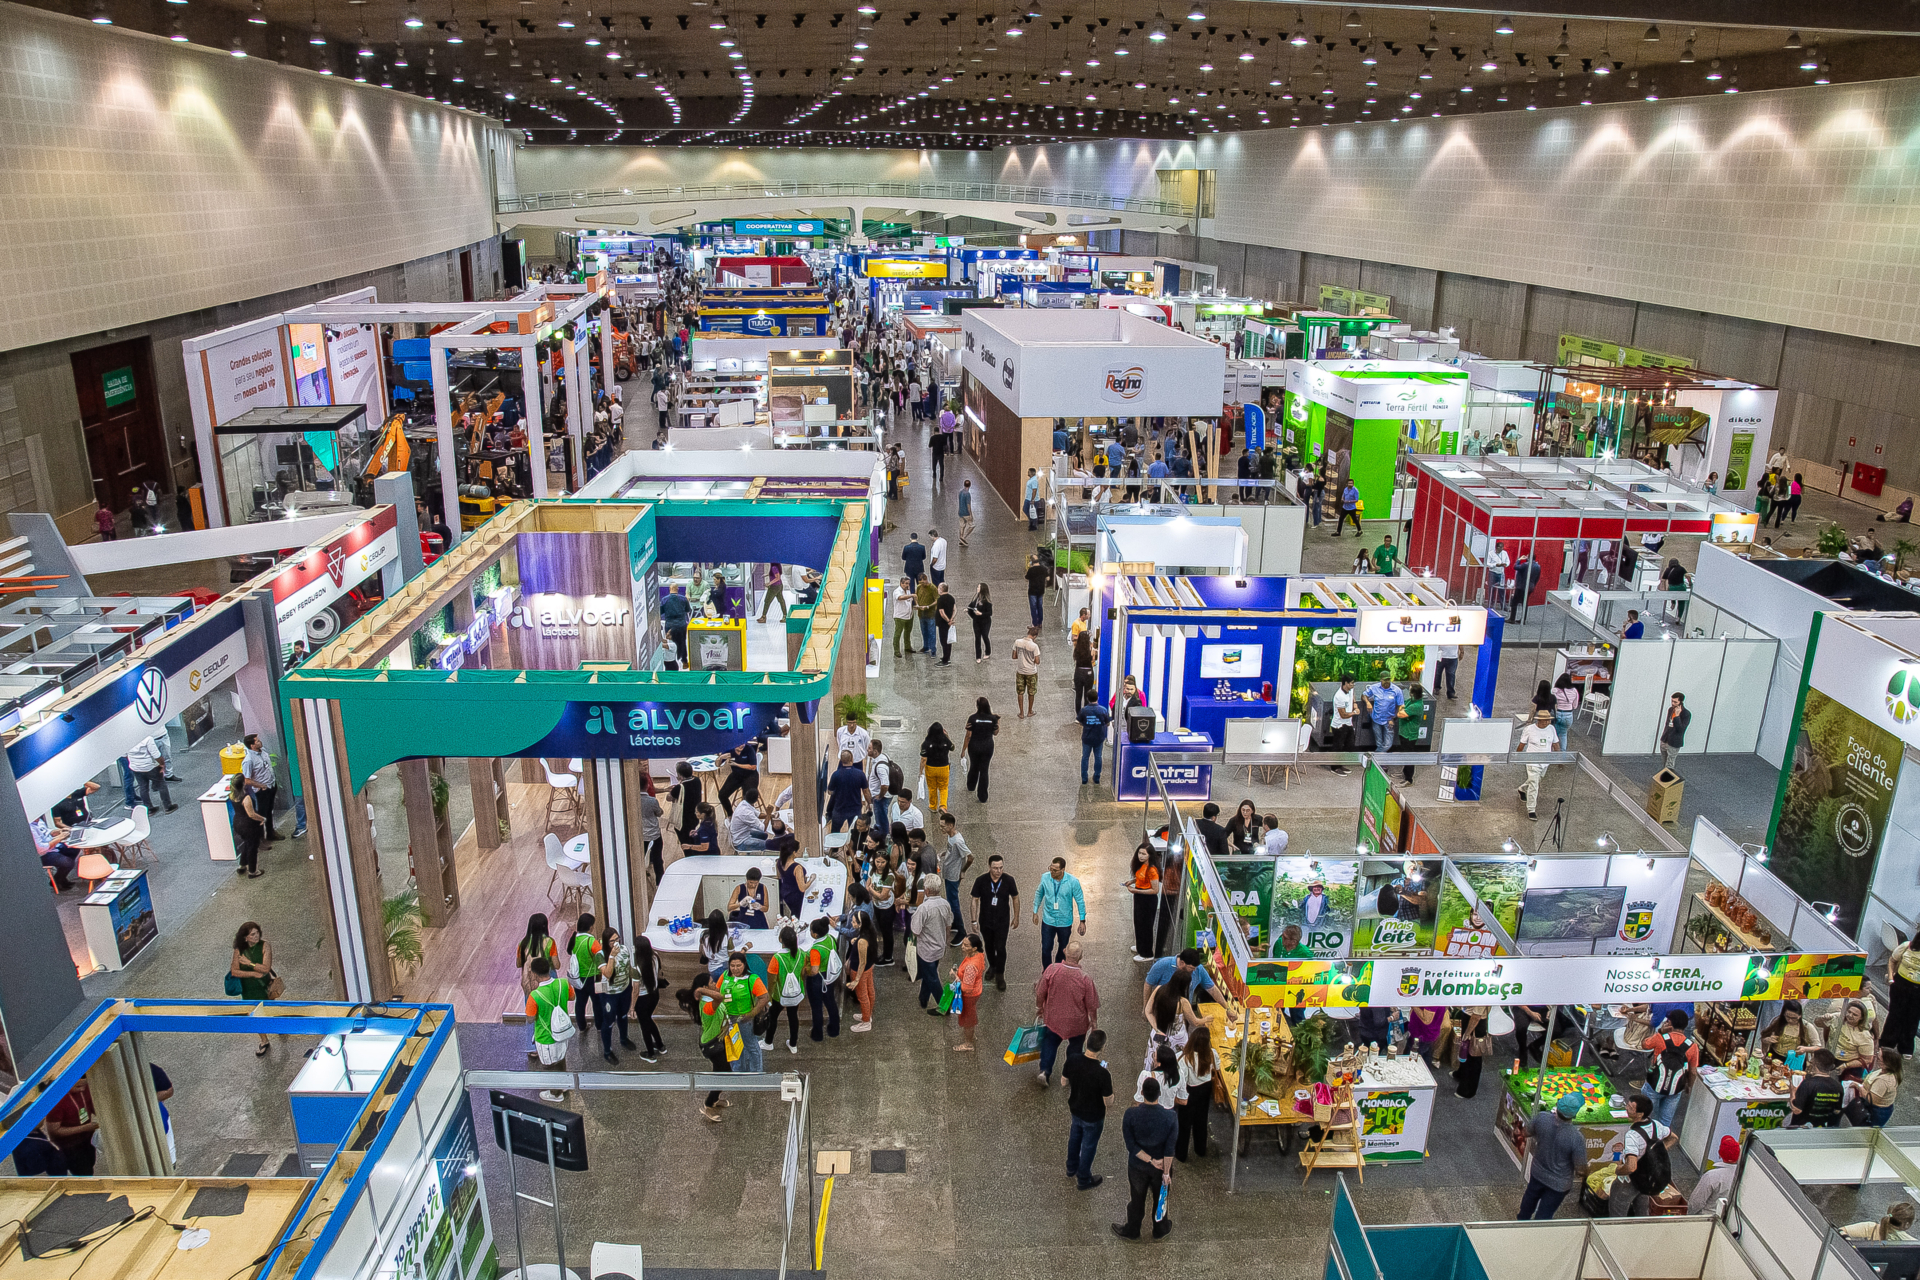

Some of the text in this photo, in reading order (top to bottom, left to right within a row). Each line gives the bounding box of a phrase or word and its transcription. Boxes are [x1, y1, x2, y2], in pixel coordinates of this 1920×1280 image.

[230, 348, 272, 370] Grandes soluções
[235, 362, 274, 387] para seu negócio
[1105, 375, 1141, 392] Regina
[234, 393, 242, 402] em
[242, 386, 257, 399] nossa
[257, 381, 267, 392] sala
[1386, 402, 1427, 411] Terra Fértil
[1556, 399, 1580, 412] dikoko
[1653, 413, 1690, 423] dikoko
[368, 545, 386, 562] CEQUIP
[278, 586, 327, 624] ASSEY FERGUSON
[542, 628, 579, 636] lácteos
[1387, 620, 1461, 633] Central
[1346, 646, 1406, 654] Geradores
[202, 654, 229, 678] CEQUIP
[630, 734, 681, 746] lácteos
[1847, 736, 1887, 769] Foco do
[1846, 752, 1894, 791] cliente
[1843, 824, 1863, 842] Galvani
[1373, 925, 1415, 943] Leite
[1385, 920, 1412, 930] mais
[1451, 928, 1497, 947] MOM
[1424, 970, 1480, 978] Prefeitura
[1422, 979, 1523, 1001] Mombaça
[1604, 980, 1723, 993] Nosso ORGULHO
[1376, 1107, 1406, 1125] PEC
[394, 1183, 437, 1268] 10 tipos de
